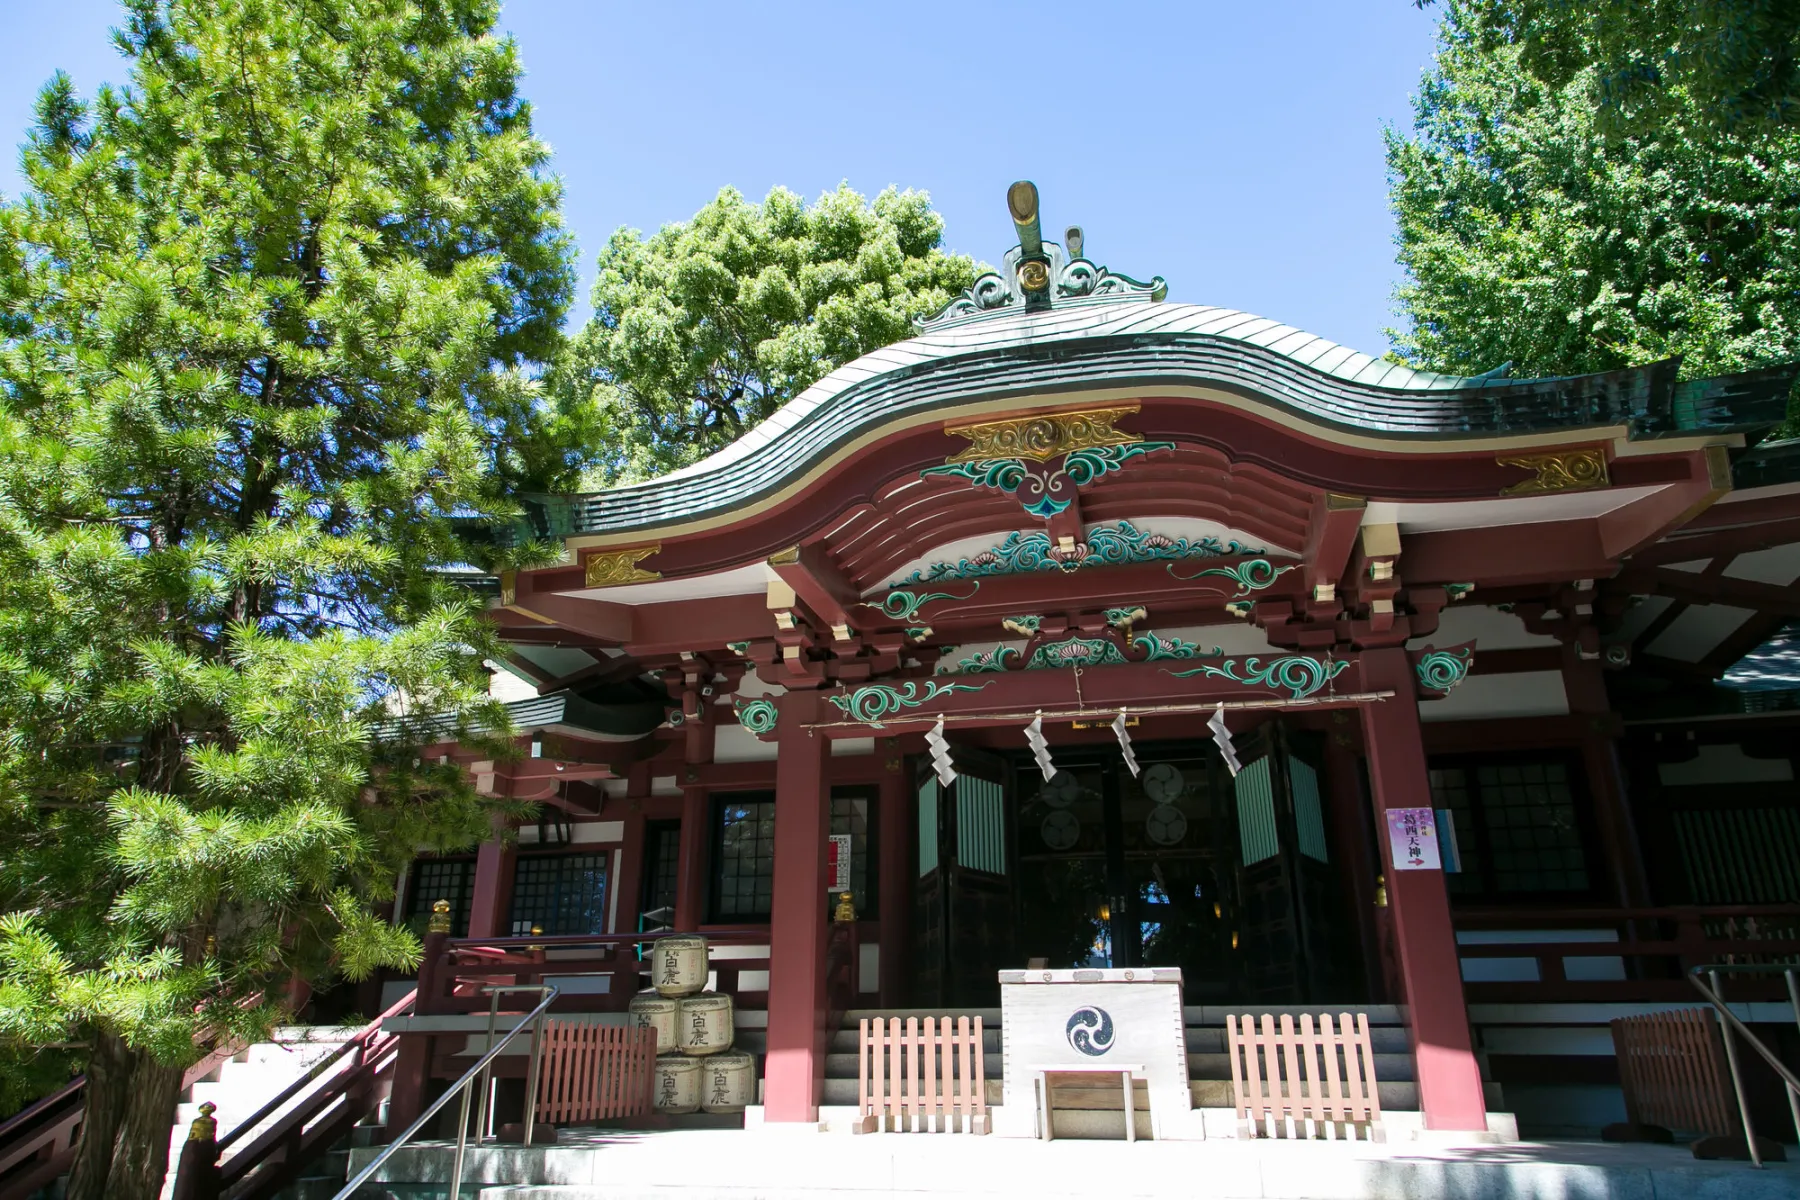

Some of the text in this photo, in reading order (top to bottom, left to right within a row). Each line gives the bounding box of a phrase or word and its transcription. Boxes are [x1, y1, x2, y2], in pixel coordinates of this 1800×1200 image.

[1404, 814, 1421, 858] 葛西天神
[661, 956, 681, 985] 白鹿
[690, 1016, 709, 1046] 白鹿
[659, 1076, 679, 1107] 白鹿
[711, 1073, 731, 1105] 白鹿
